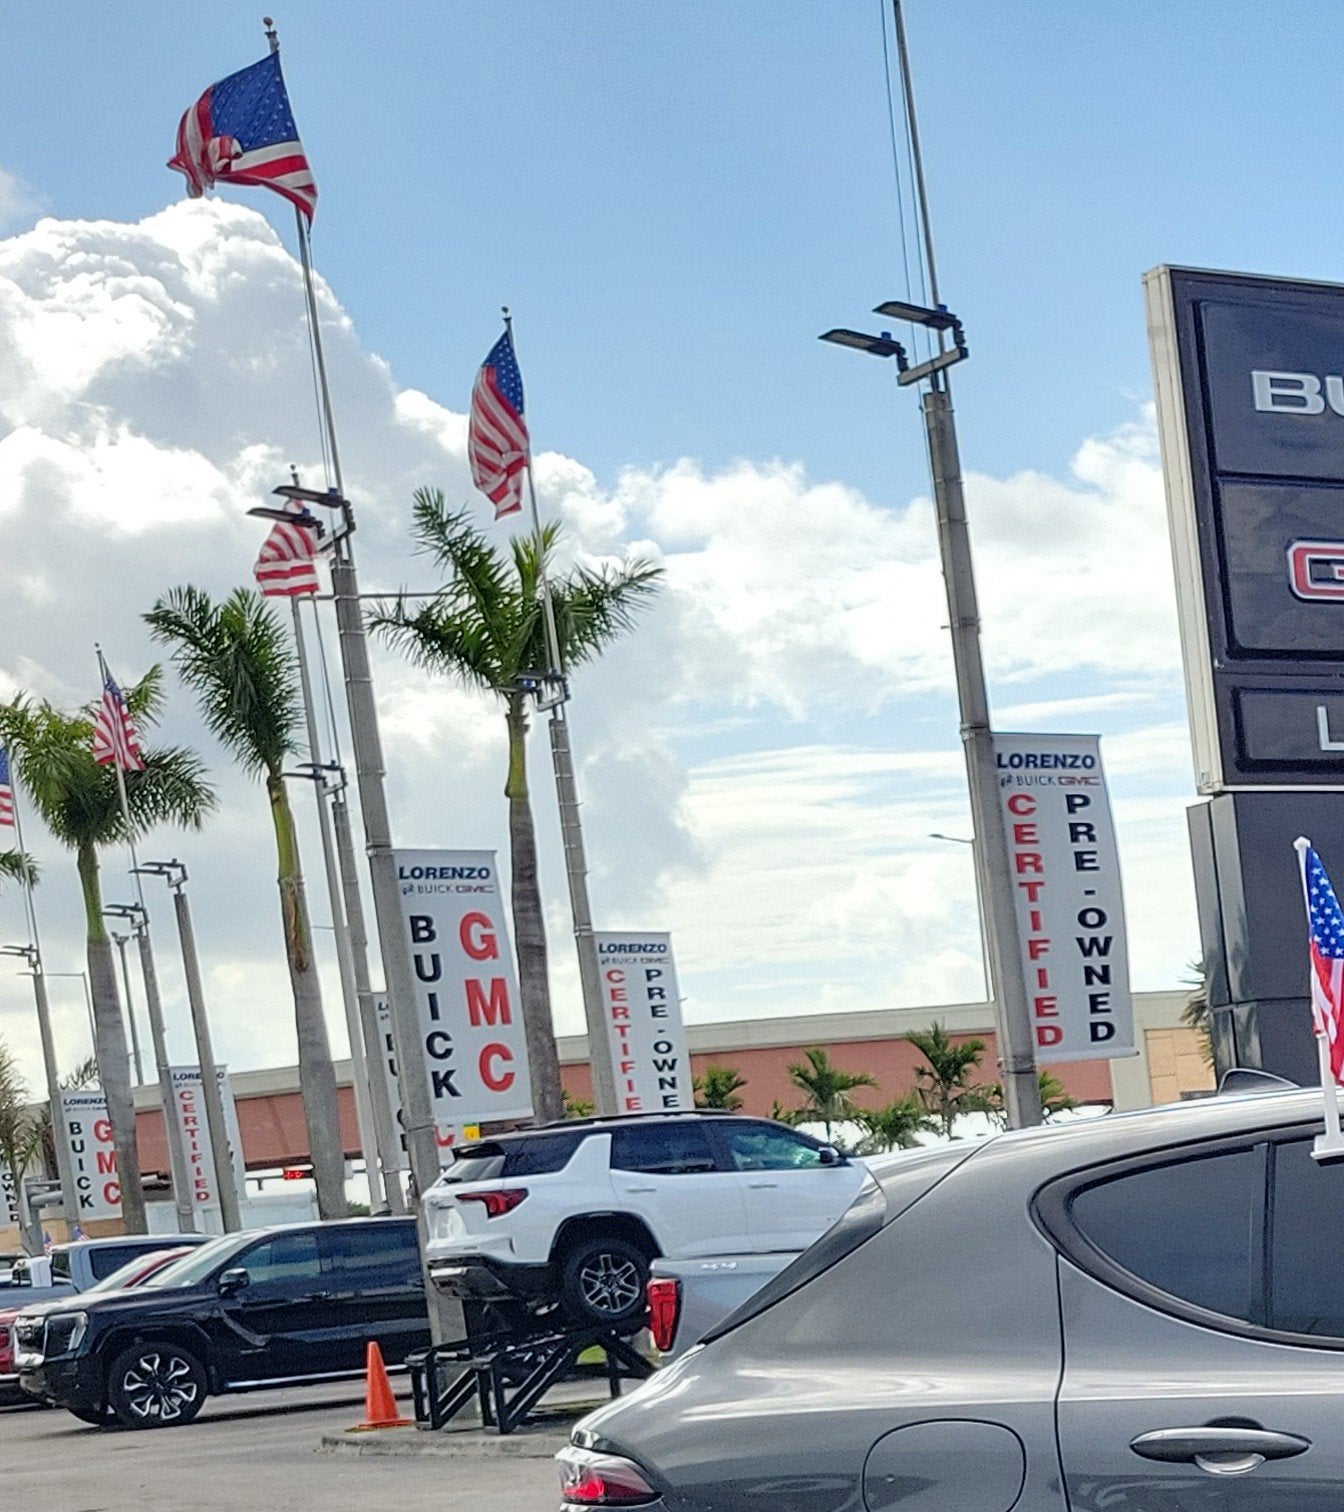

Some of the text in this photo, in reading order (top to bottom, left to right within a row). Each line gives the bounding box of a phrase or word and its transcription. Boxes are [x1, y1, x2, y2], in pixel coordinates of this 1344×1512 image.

[996, 752, 1096, 770] LORENZO
[1016, 775, 1100, 787] BUICK GMC
[399, 866, 490, 880] LORENZO
[417, 884, 453, 895] BUICK
[1008, 793, 1064, 1048] CERTIFIED
[1065, 793, 1116, 1044] PRE-OWNED
[598, 942, 667, 954] LORENZO
[409, 914, 462, 1100] BUICK
[459, 911, 516, 1093] GMC
[606, 968, 643, 1112] CERTIFIE
[645, 968, 680, 1109] PRE-OWNE
[69, 1121, 95, 1209] BUICK
[93, 1119, 122, 1205] GMC
[179, 1090, 210, 1203] CERTIFIED
